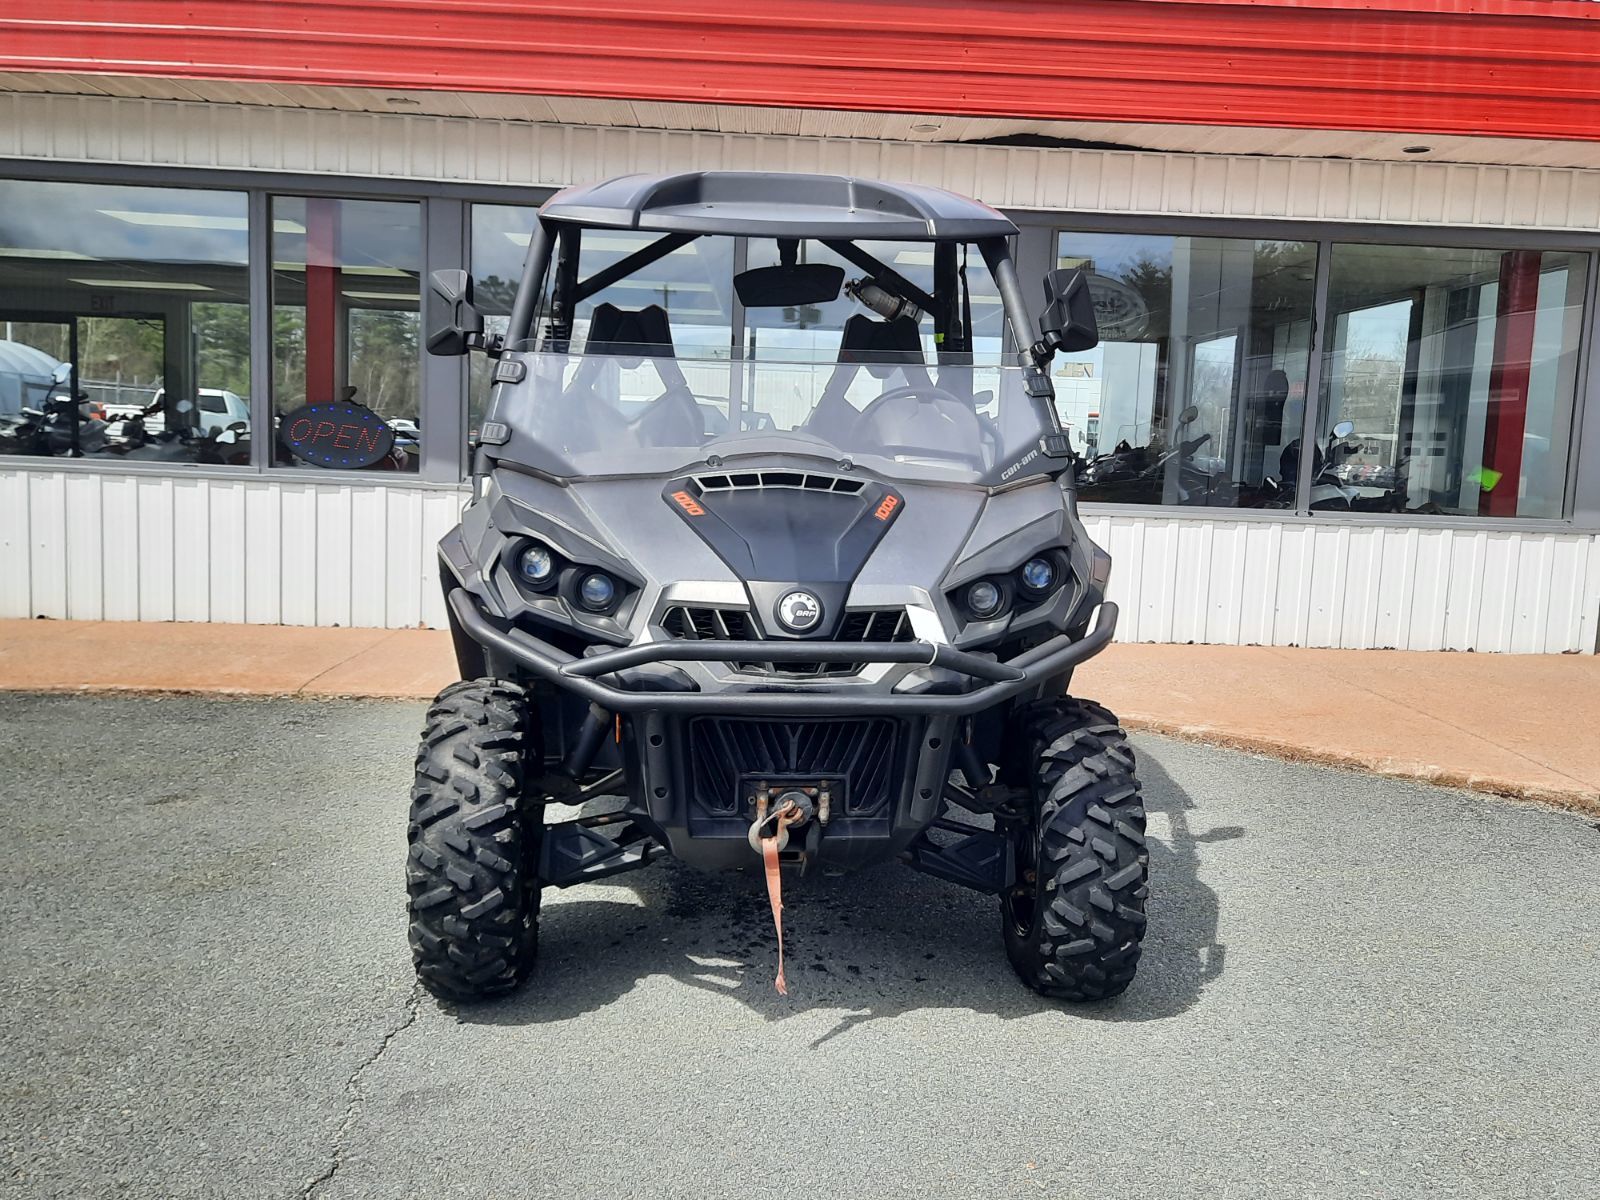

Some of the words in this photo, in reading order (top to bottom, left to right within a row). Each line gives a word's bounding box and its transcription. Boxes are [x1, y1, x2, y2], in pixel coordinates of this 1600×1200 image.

[290, 418, 383, 452] OPEN
[671, 491, 705, 516] 1000
[874, 495, 898, 521] 1000
